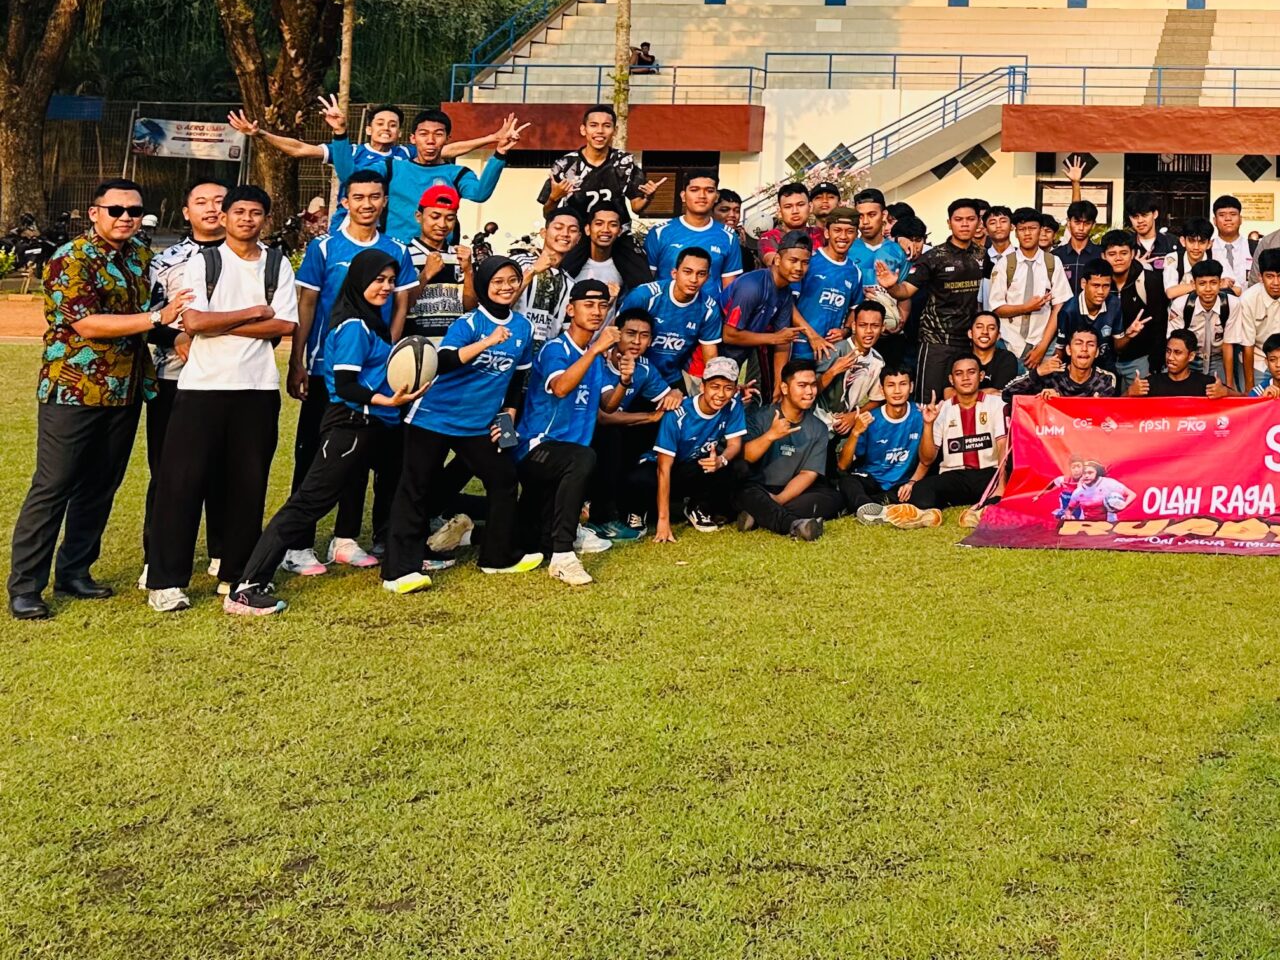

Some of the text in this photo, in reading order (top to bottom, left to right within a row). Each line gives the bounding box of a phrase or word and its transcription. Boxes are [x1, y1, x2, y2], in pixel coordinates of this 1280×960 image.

[1036, 425, 1065, 436] UMM
[965, 435, 990, 444] PERMATA
[1142, 486, 1202, 515] OLAH
